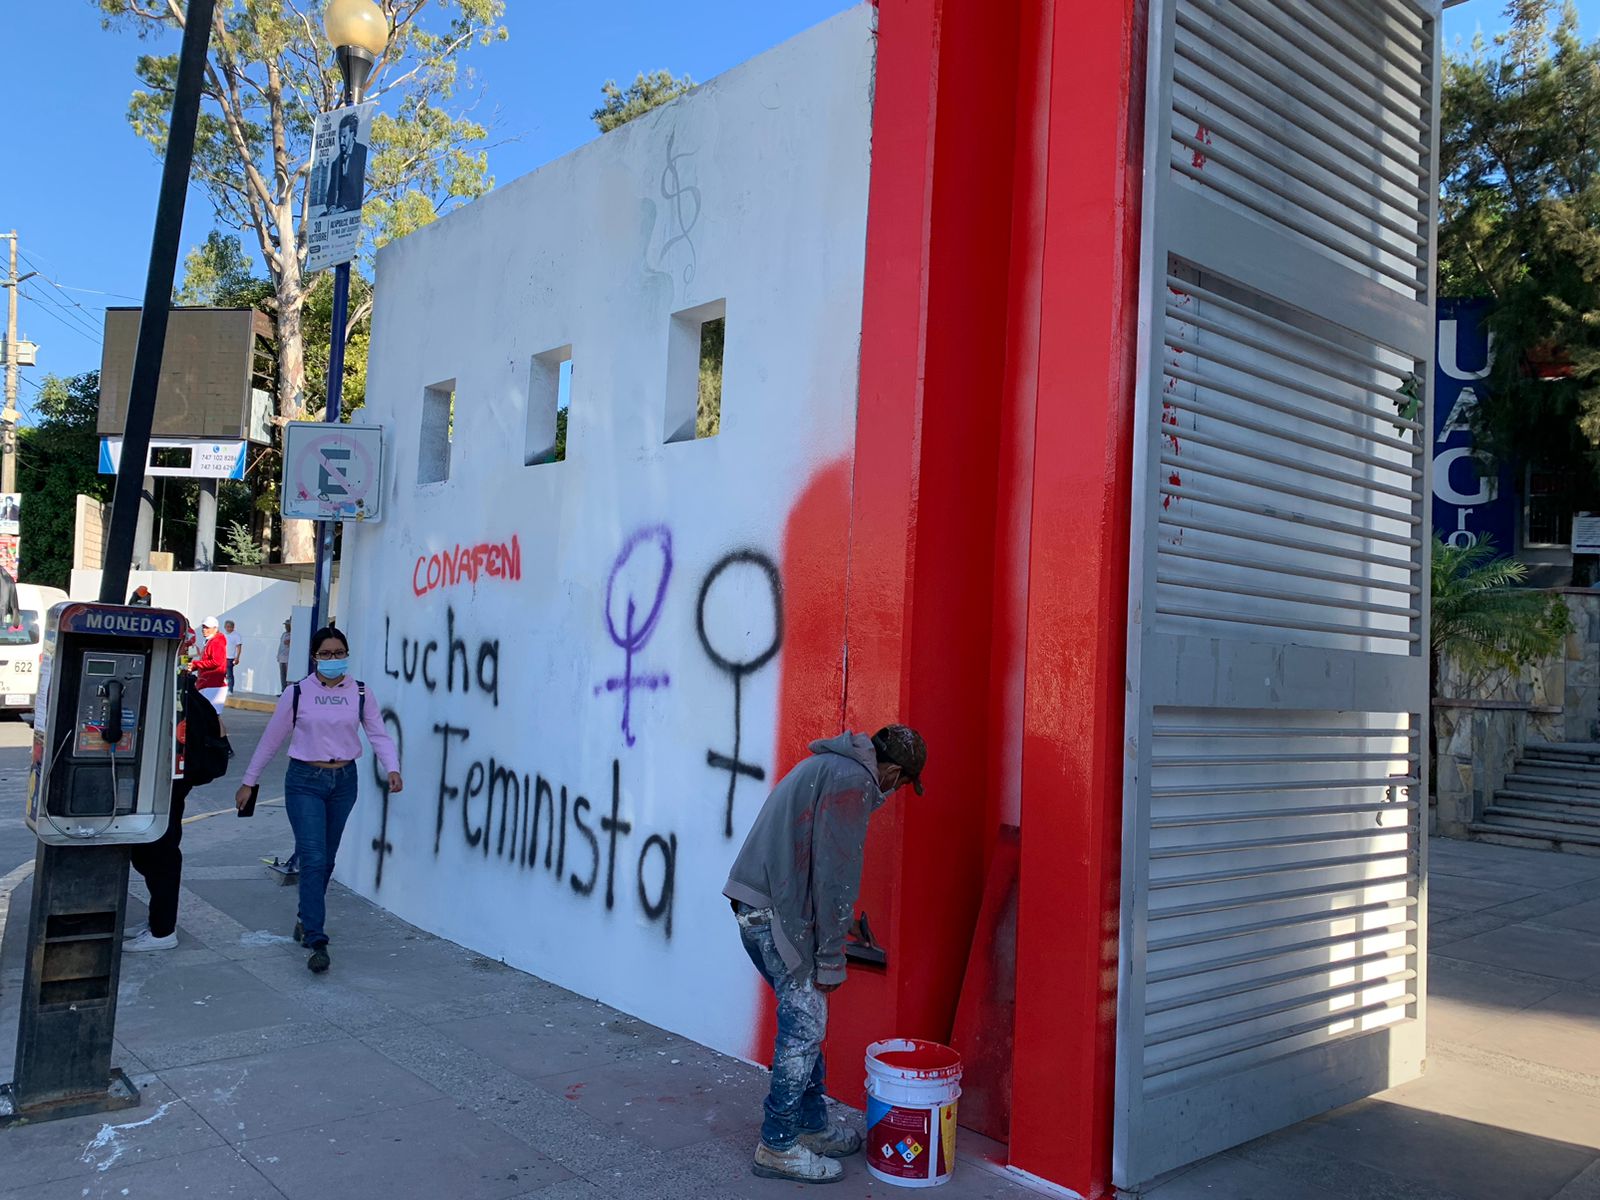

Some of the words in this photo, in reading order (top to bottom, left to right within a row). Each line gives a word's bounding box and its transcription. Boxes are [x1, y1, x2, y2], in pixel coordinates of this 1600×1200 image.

[314, 221, 321, 233] 30
[319, 449, 350, 494] E
[412, 534, 521, 596] CONAFEN
[86, 614, 175, 634] MONEDAS
[14, 662, 32, 672] 622
[384, 605, 499, 705] Lucha
[315, 696, 349, 706] NASA
[433, 722, 677, 939] Feminista
